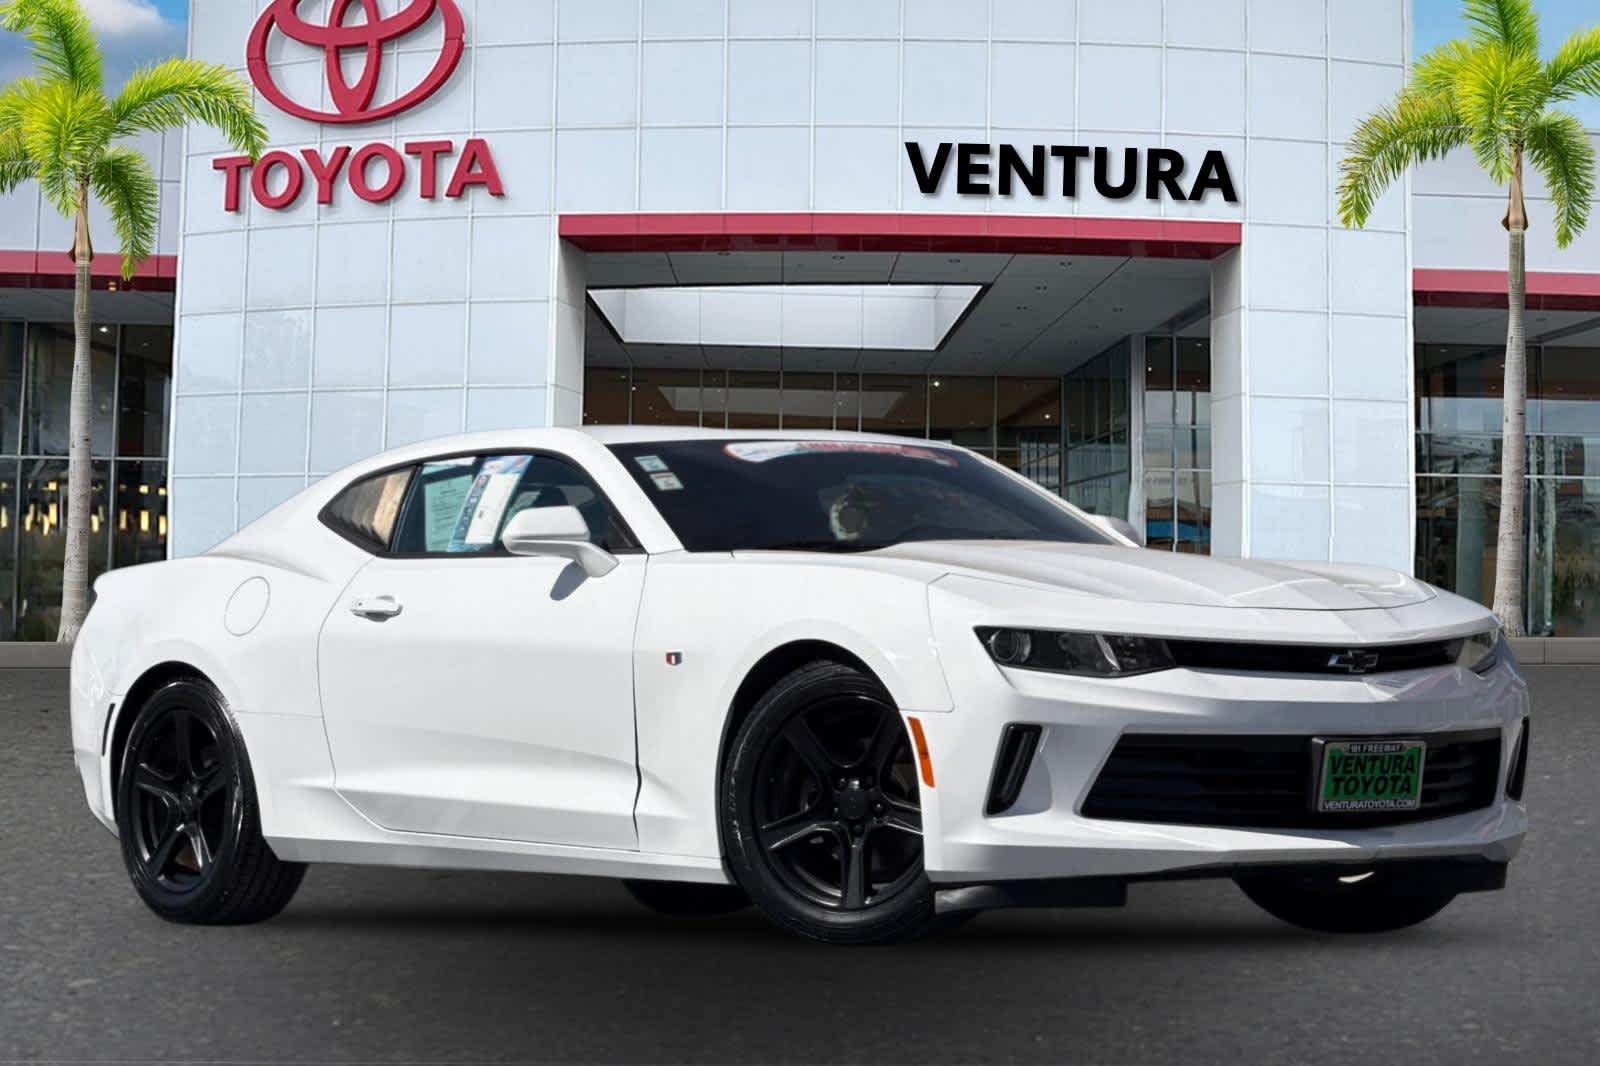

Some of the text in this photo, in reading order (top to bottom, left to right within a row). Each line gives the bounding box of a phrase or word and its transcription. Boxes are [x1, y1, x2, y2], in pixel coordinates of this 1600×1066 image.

[213, 139, 505, 212] TOYOTA
[905, 142, 1238, 202] VENTURA
[1330, 755, 1415, 774] VENTURA
[1332, 776, 1412, 796] TOYOTA
[1324, 799, 1416, 809] VENTURATOYOTA.COM
